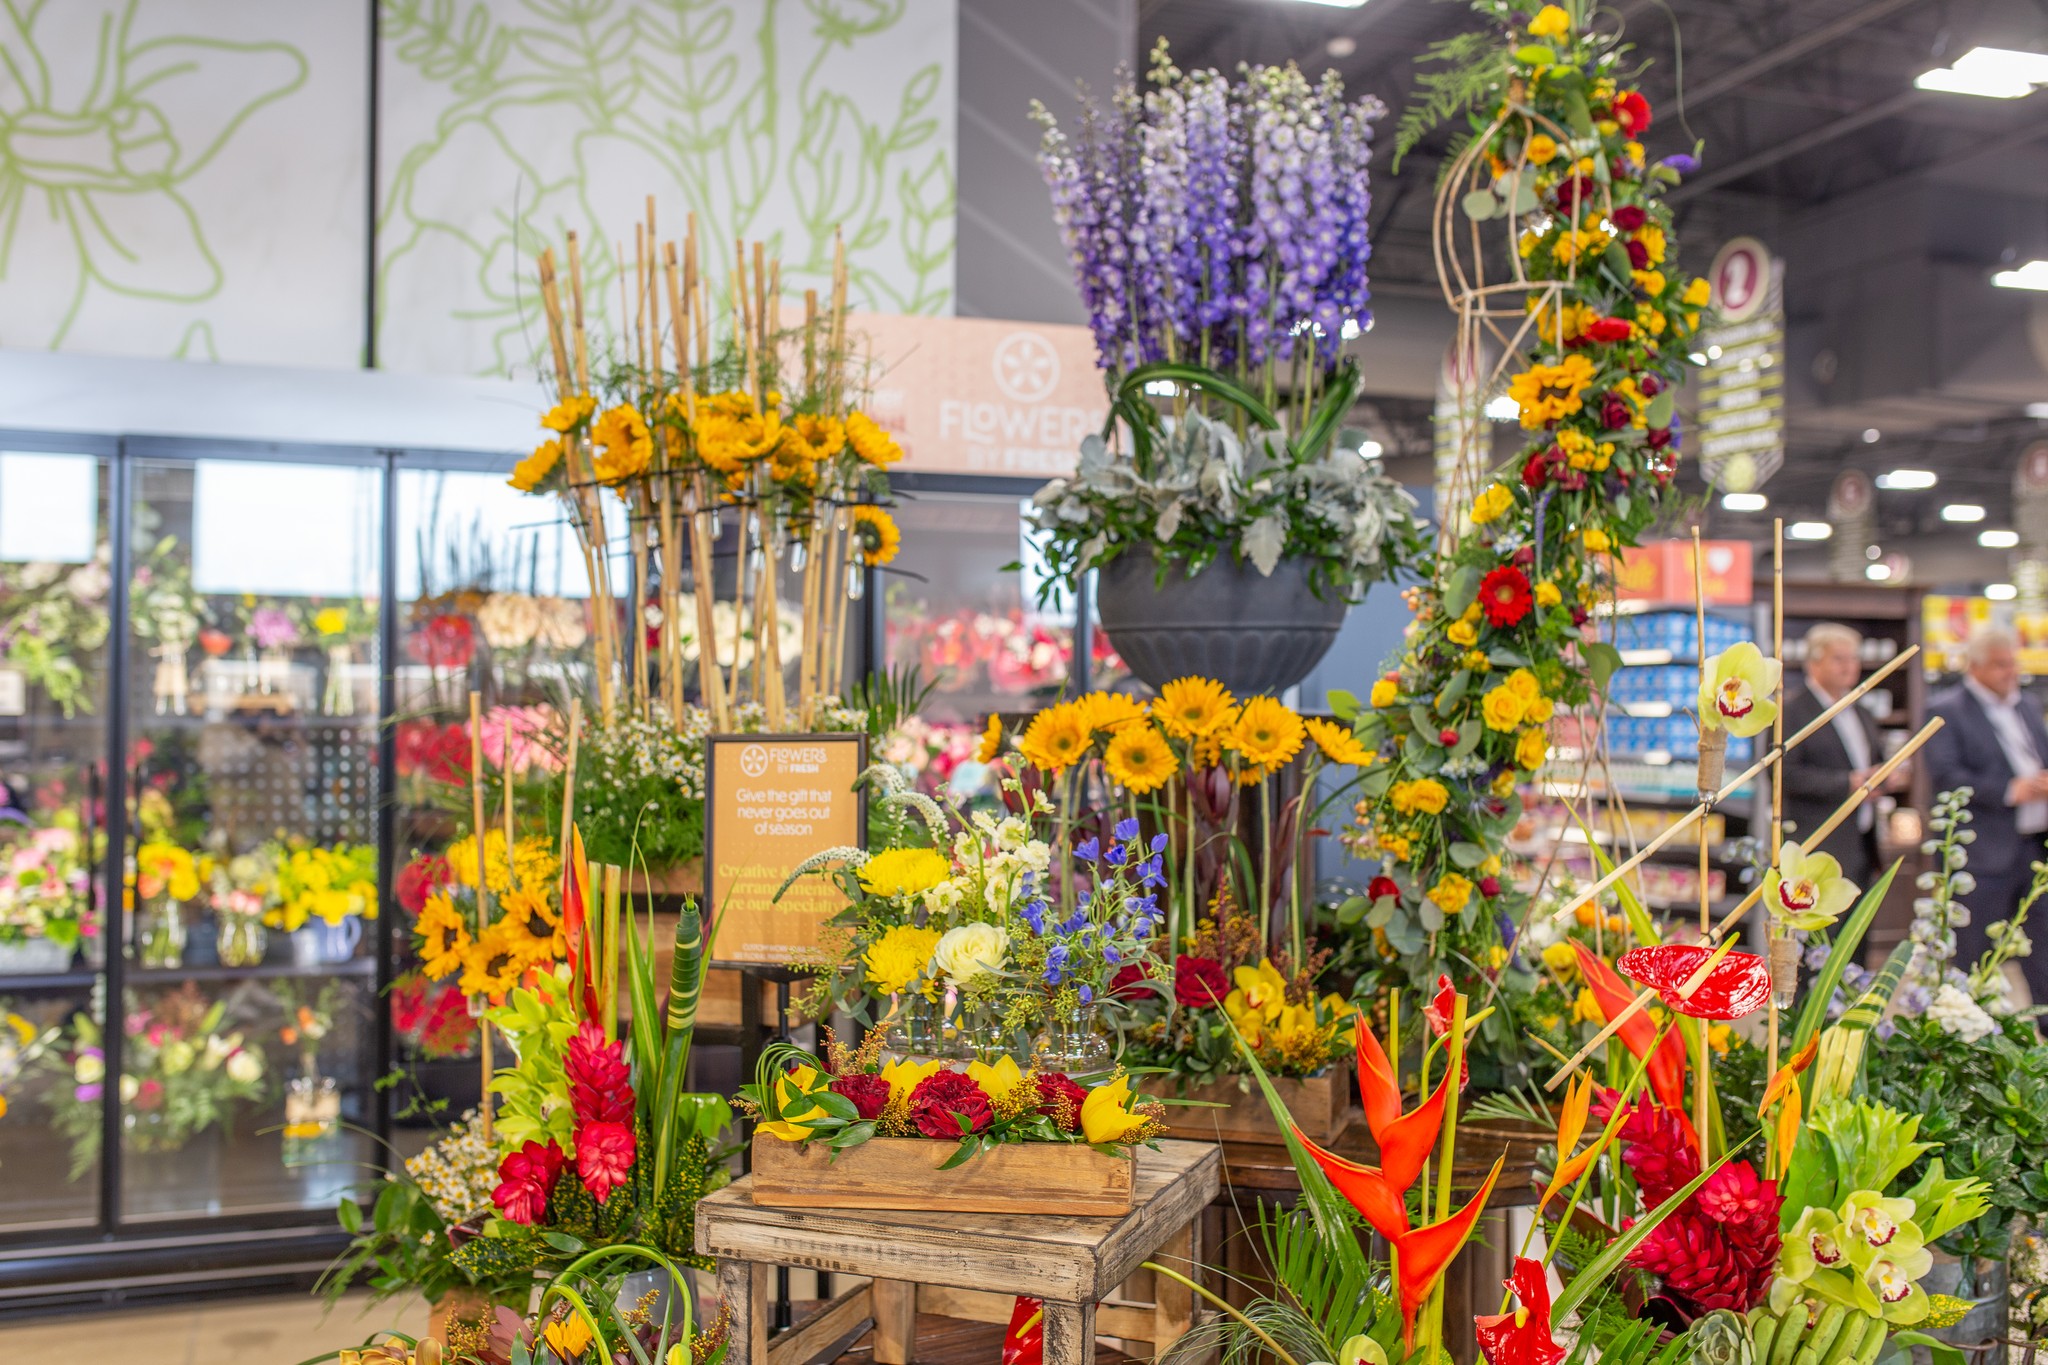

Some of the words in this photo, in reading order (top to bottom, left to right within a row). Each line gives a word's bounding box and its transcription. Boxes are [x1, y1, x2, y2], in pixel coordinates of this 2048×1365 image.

[1003, 446, 1076, 474] FRES
[769, 747, 828, 764] FLOWERS
[790, 763, 819, 774] FRESH
[736, 787, 766, 803] Give
[767, 788, 788, 803] the
[788, 788, 808, 806] gift
[809, 788, 832, 803] that
[736, 807, 773, 819] never
[775, 807, 807, 822] goes
[809, 806, 830, 820] out
[754, 821, 768, 836] of
[768, 823, 813, 836] season
[719, 863, 778, 879] Creative
[731, 883, 837, 898] arrangments
[747, 898, 771, 911] our
